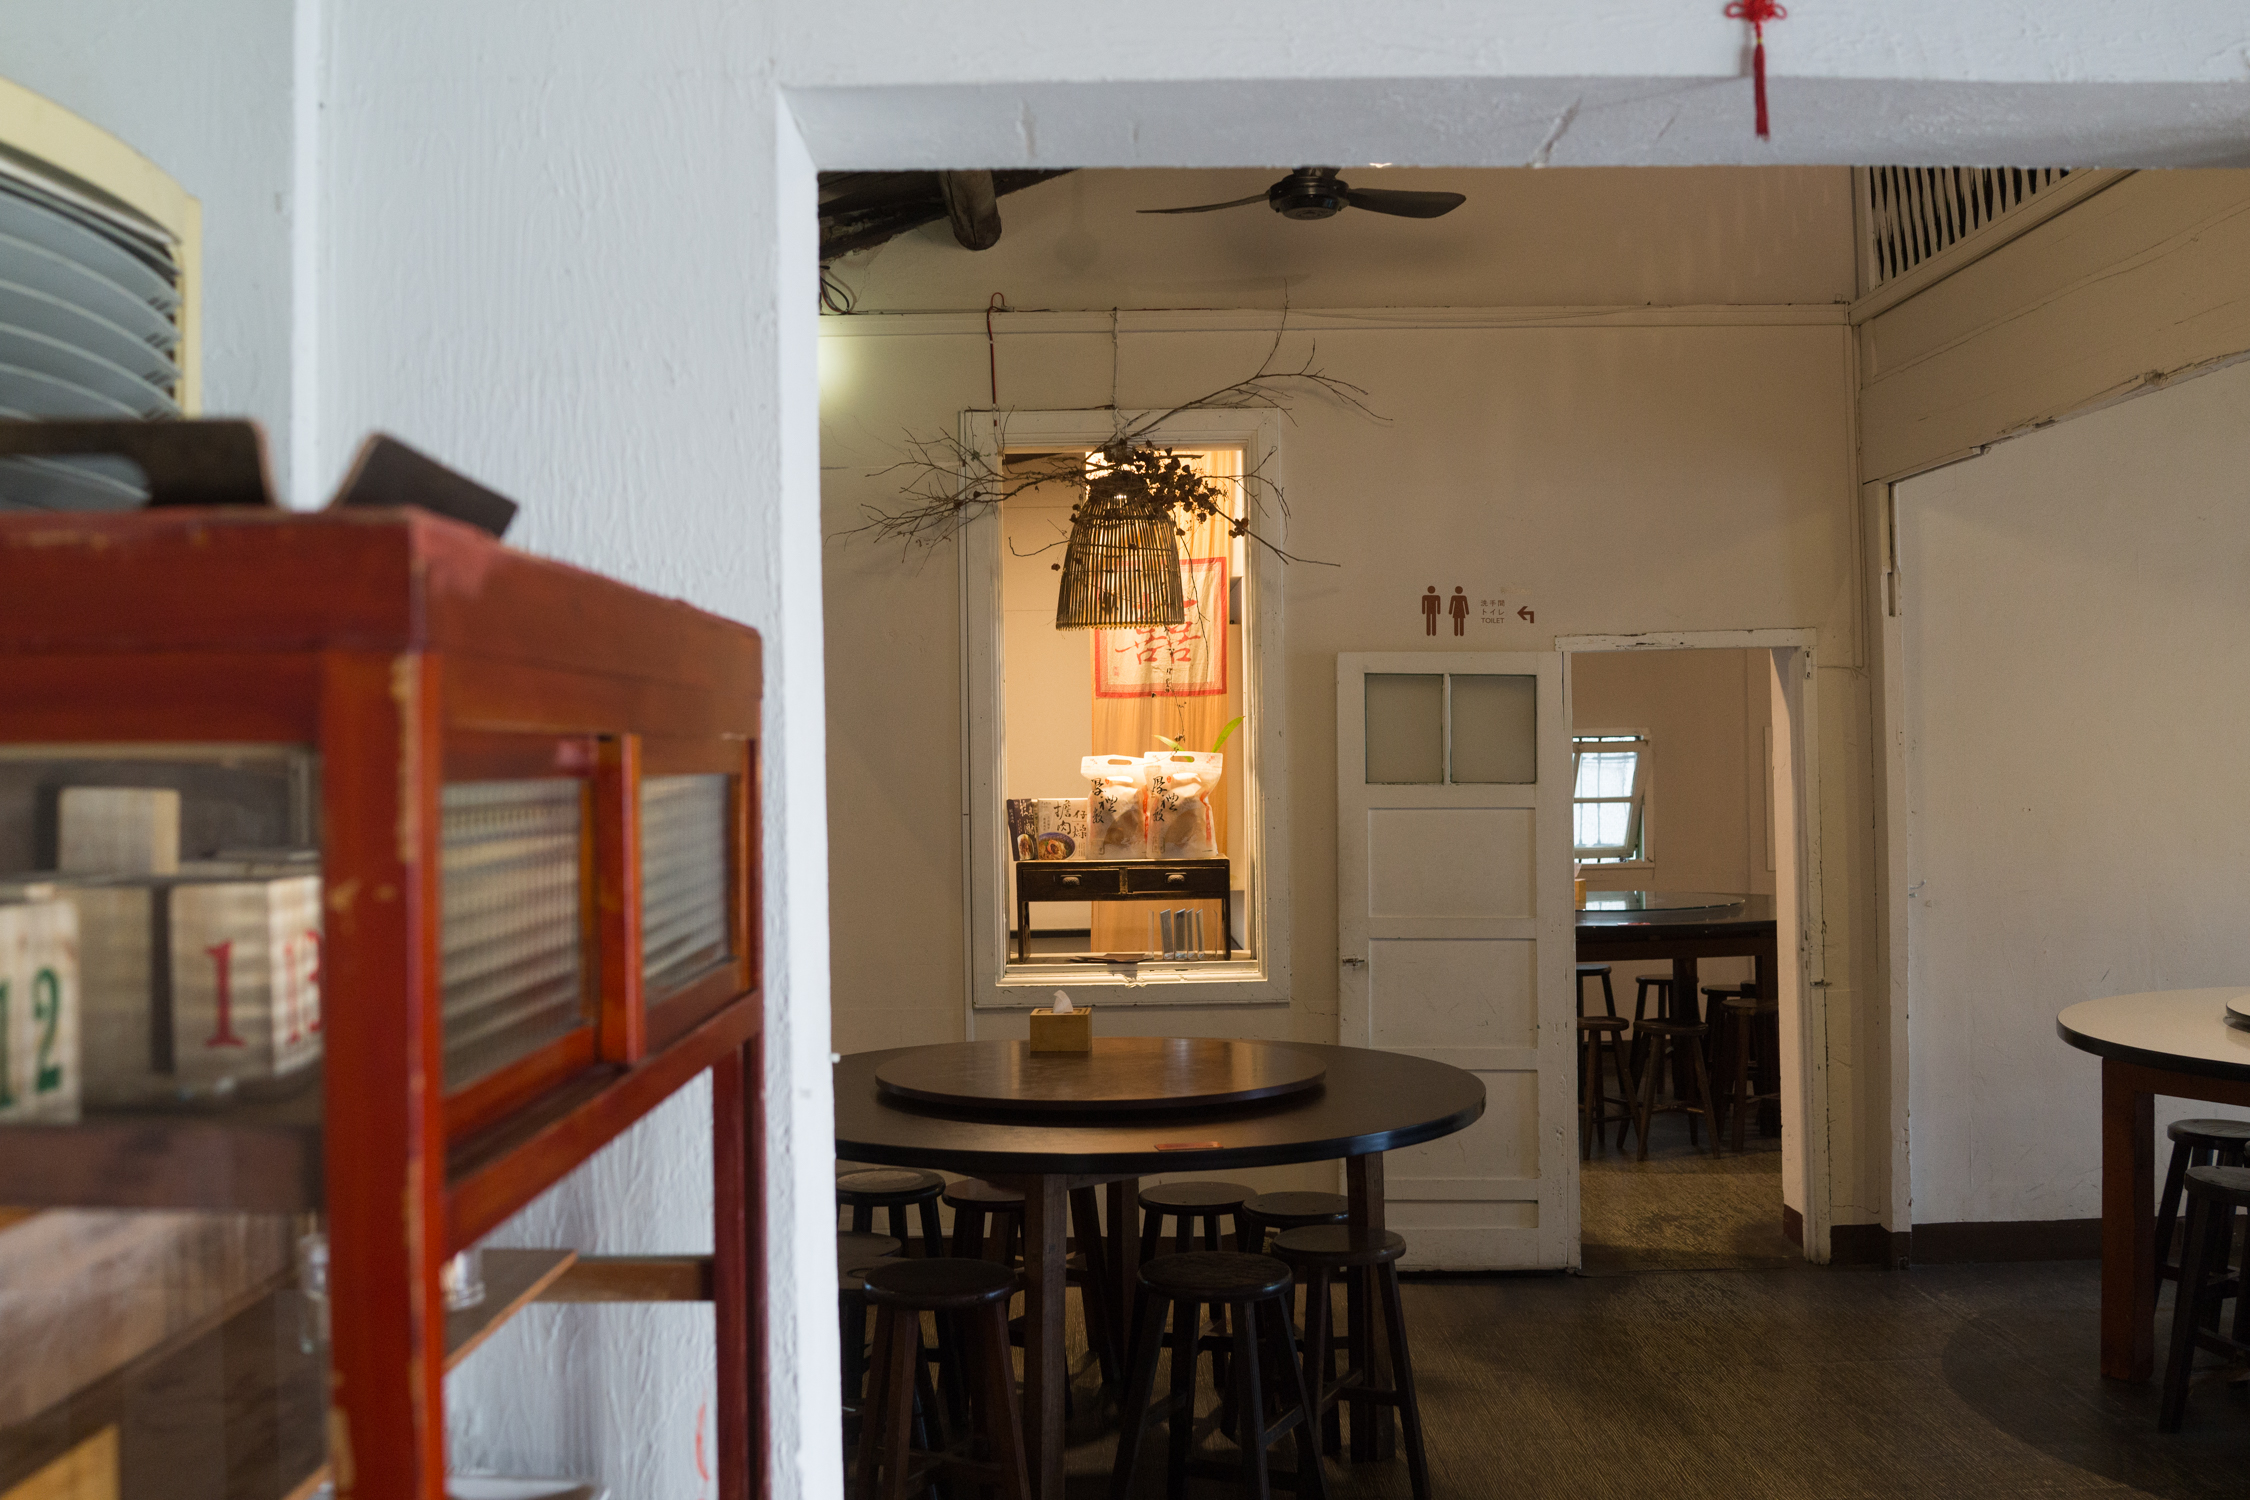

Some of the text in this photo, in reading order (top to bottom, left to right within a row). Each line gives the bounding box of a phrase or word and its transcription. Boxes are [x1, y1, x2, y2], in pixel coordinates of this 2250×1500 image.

[1482, 608, 1505, 616] トイレ
[205, 938, 246, 1048] 1
